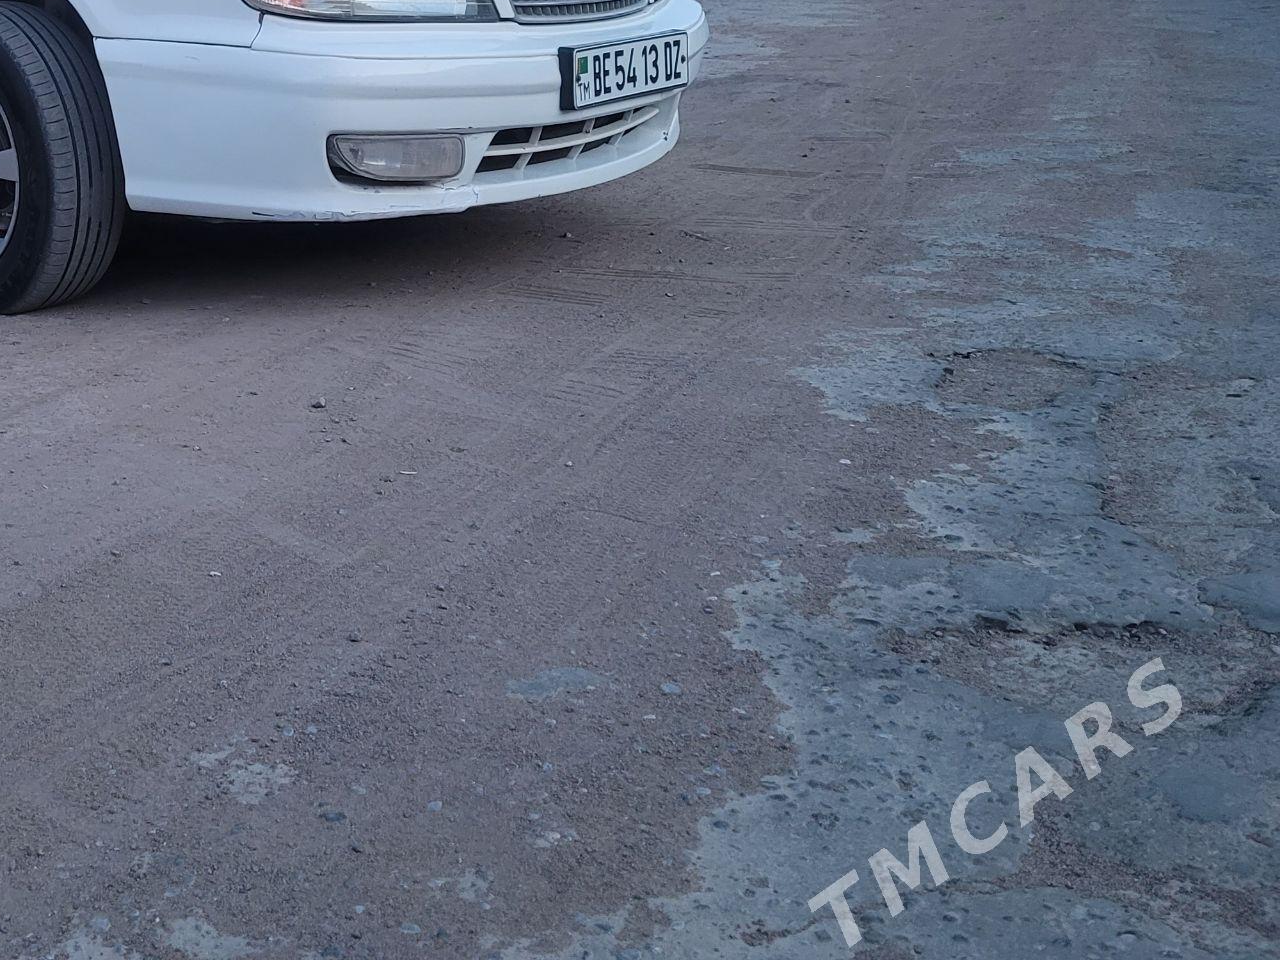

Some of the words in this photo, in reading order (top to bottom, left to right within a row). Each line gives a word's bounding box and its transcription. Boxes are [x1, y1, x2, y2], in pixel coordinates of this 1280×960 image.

[593, 52, 612, 97] BE
[664, 39, 681, 82] DZ
[577, 81, 591, 102] TM
